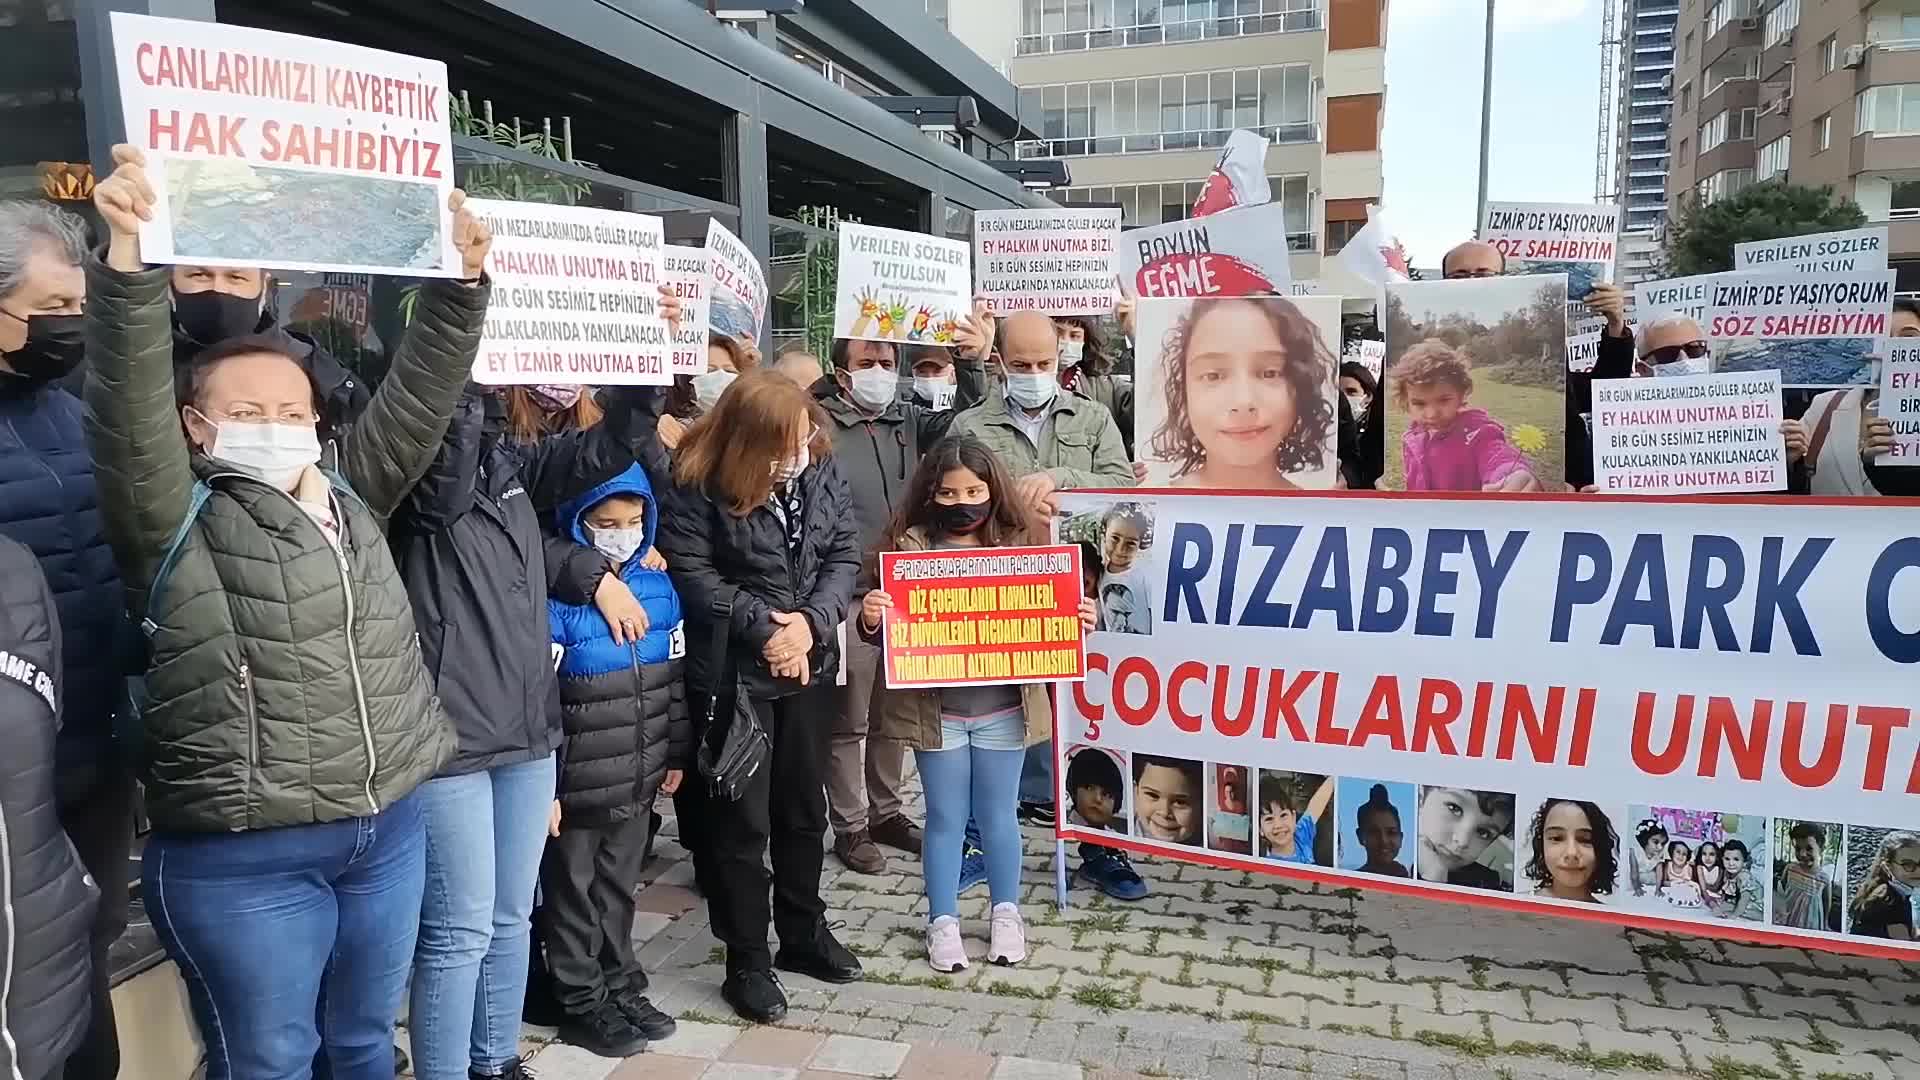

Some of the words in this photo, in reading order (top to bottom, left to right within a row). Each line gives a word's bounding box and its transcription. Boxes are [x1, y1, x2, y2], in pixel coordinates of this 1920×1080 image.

[137, 42, 316, 104] CANLARIMIZI
[326, 67, 439, 122] KAYBETTİK
[150, 109, 247, 157] HAK
[261, 118, 443, 179] SAHİBİYİZ
[507, 218, 593, 243] MEZARLARIMIZDA
[993, 217, 1008, 232] GÜN
[1067, 216, 1090, 231] GÜLLER
[1488, 206, 1546, 231] İZMİR'DE
[1548, 211, 1616, 235] YAŞIYORUM
[914, 241, 964, 267] SÖZLER
[983, 240, 997, 254] EY
[999, 239, 1040, 253] HALKIM
[1043, 238, 1088, 252] UNUTMA
[1488, 234, 1523, 257] ÖZ
[1526, 236, 1613, 260] SAHİBİYİM
[1745, 244, 1812, 264] VERİLEN
[1817, 237, 1880, 256] SÖZLER
[493, 250, 559, 277] HALKIM
[562, 254, 627, 280] UNUTMA
[872, 260, 947, 285] TUTULSUN
[990, 258, 1004, 274] BİR
[1007, 257, 1027, 274] GÜN
[1029, 257, 1063, 273] SESİMİZ
[1065, 256, 1109, 272] HEPİNİZİN
[676, 278, 702, 300] BİZİ.
[982, 279, 1048, 292] KULAKLARINDA
[1051, 277, 1116, 291] YANKILANACAK
[1647, 283, 1707, 305] VERİLE
[1712, 280, 1785, 306] İZMİR'DE
[1789, 281, 1888, 310] YAŞIYORUM
[512, 283, 545, 309] GÜN
[548, 284, 597, 311] SESİMİZ
[600, 288, 655, 315] HEPİNİZİN
[987, 298, 999, 310] EY
[1003, 295, 1035, 310] İZMİR
[1039, 296, 1087, 309] UNUTMA
[1091, 293, 1113, 308] BİZİ
[583, 322, 665, 345] YANKILANACAK
[1711, 311, 1757, 336] SÖZ
[1762, 308, 1886, 336] SAHİBİYİM
[488, 352, 506, 372] EY
[513, 345, 564, 373] İZMİR
[568, 352, 634, 374] UNUTMA
[639, 350, 662, 374] BİZİ
[673, 348, 697, 366] BİZİ
[1891, 346, 1906, 362] BİR
[1600, 389, 1612, 402] BİR
[1613, 387, 1632, 402] GÜN
[1634, 385, 1706, 401] MEZARLARIMIZDA
[1708, 381, 1739, 397] GÜLLER
[1892, 373, 1910, 388] EY
[1602, 412, 1616, 426] EY
[1621, 409, 1672, 425] HALKIM
[1677, 406, 1737, 423] UNUTMA
[1742, 400, 1774, 419] BİZİ.
[1611, 432, 1628, 448] BİR
[1632, 429, 1657, 448] GÜN
[1661, 427, 1704, 446] SESİMİZ
[1707, 425, 1767, 444] HEPİNİZİN
[1602, 453, 1686, 469] KULAKLARINDA
[1689, 449, 1779, 466] YANKILANACAK
[1609, 475, 1623, 489] EY
[1628, 470, 1670, 488] İZMİR
[1675, 471, 1740, 486] UNUTMA
[1745, 466, 1774, 484] BİZİ
[1162, 522, 1530, 639] RIZABEY
[1549, 531, 1836, 657] PARK
[909, 585, 929, 614] BİZ
[930, 586, 998, 620] ÇOCUKLARIN
[890, 618, 910, 648] SİZ
[911, 616, 977, 647] BÜYÜKLERİN
[978, 614, 1042, 645] VİCDANLARI
[1044, 616, 1079, 642] BETON
[967, 651, 1011, 678] ALTINDA
[1072, 653, 1598, 767] ÇOCUKLARINI
[1630, 692, 1920, 794] UNUT
